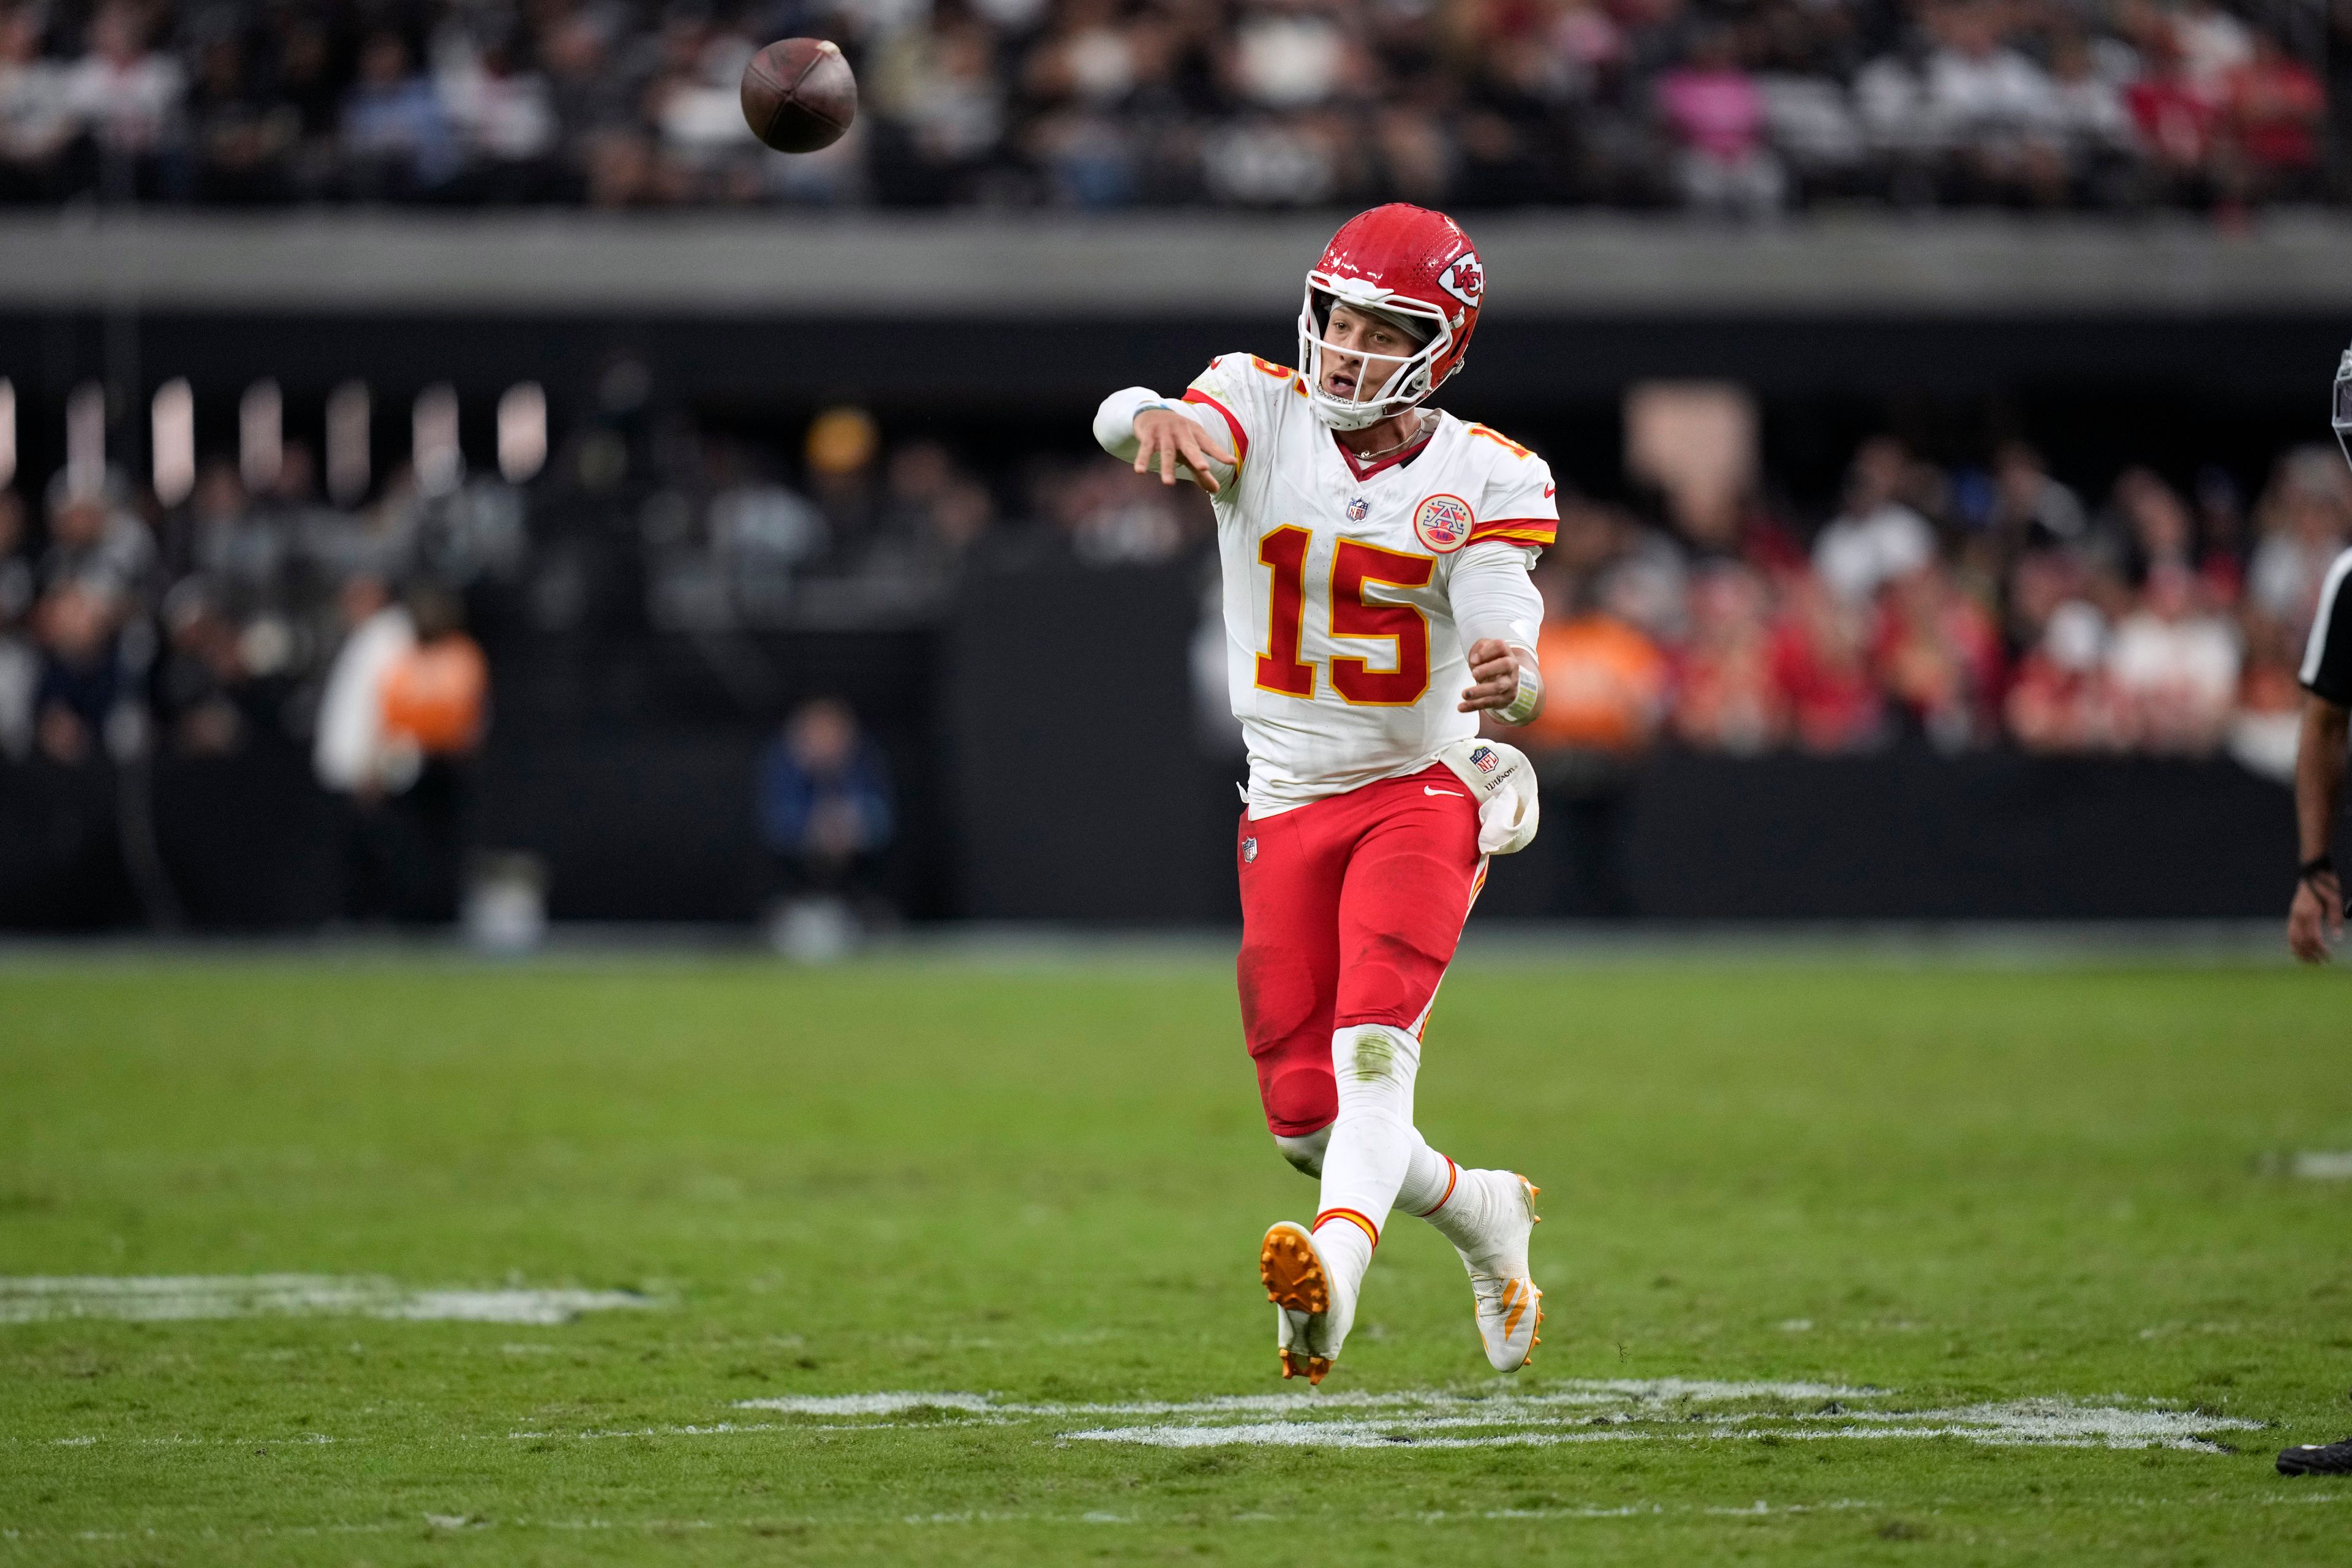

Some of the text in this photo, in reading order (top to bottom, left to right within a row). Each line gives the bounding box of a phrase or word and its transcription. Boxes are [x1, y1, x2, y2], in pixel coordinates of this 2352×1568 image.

[1451, 264, 1481, 298] KC
[1254, 524, 1438, 707] 15
[1477, 754, 1497, 772] NFL
[1485, 767, 1515, 791] Wilson
